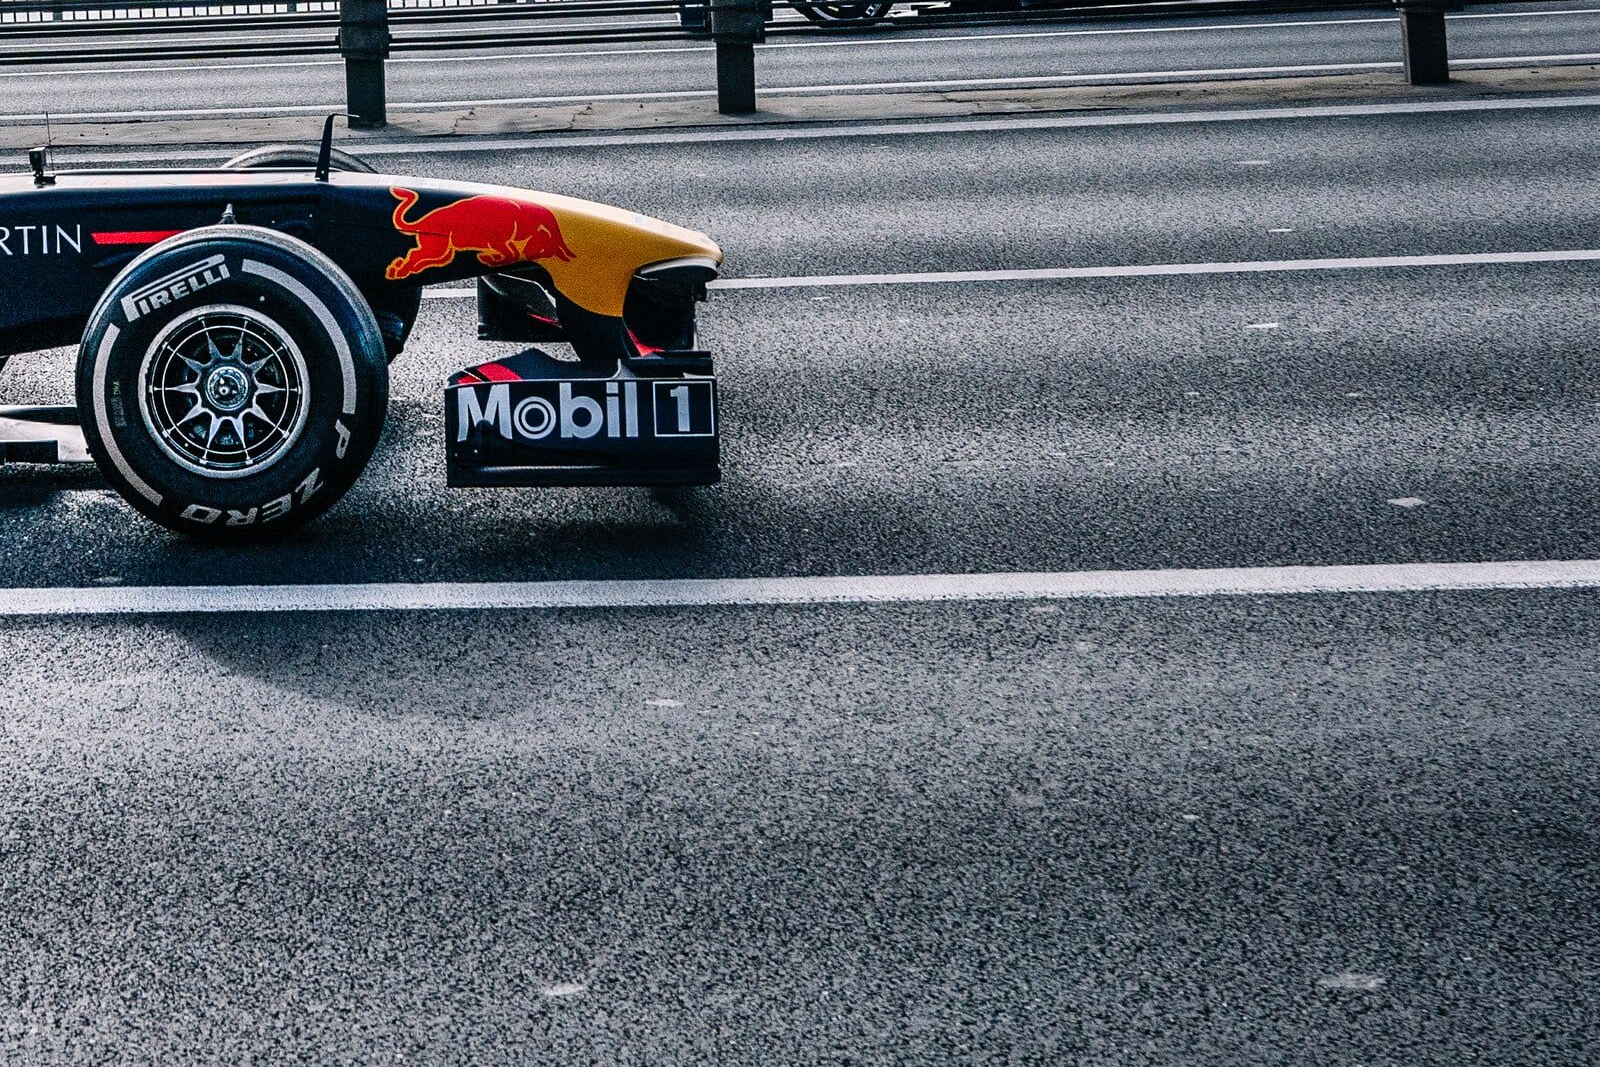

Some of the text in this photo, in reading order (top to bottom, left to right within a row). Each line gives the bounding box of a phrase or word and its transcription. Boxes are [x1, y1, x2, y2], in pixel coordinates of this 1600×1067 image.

[120, 253, 231, 323] PIRELLI
[457, 381, 691, 442] Mobil 1
[180, 419, 351, 526] P ZERO
